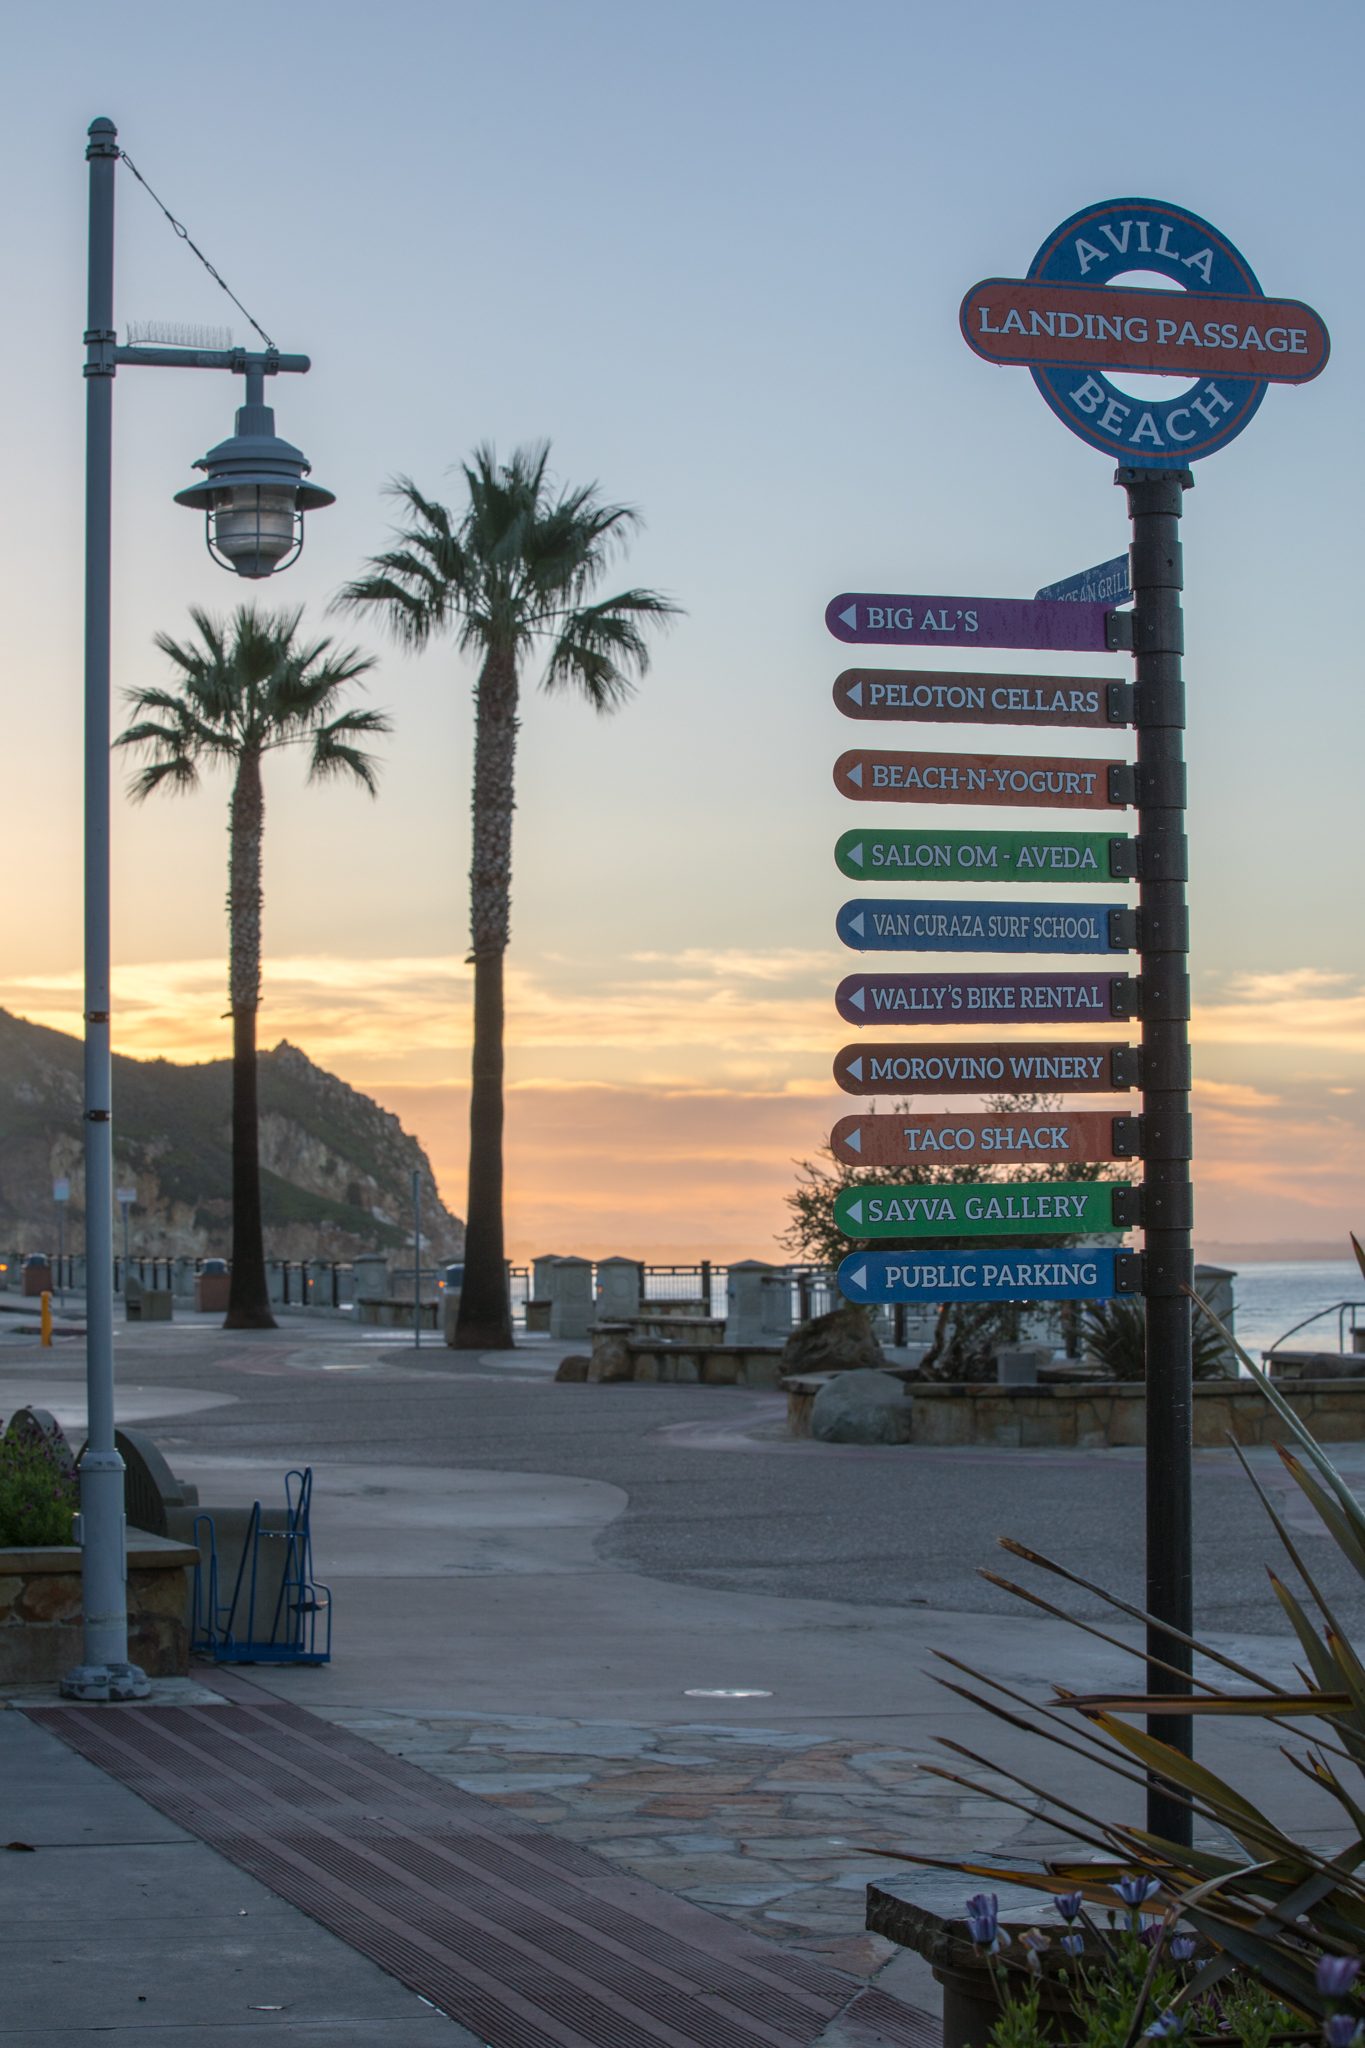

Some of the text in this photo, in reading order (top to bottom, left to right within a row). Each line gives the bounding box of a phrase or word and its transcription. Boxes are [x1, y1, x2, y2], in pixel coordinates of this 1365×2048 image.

[1073, 220, 1216, 285] AVILA
[978, 306, 1309, 355] LANDING PASSAGE
[1069, 375, 1234, 446] BEACH
[866, 606, 979, 632] BIG AL'S
[869, 683, 1099, 713] PELOTON CELLARS
[872, 764, 1097, 795] BEACH-N-YOGURT
[871, 844, 952, 867] SALON
[957, 845, 998, 867] OM
[1016, 846, 1098, 869] AVEDA
[873, 914, 1099, 939] VAN CURAZA SURF SCHOOL
[871, 985, 1103, 1010] WALLY'S BIKE RENTAL
[870, 1056, 1104, 1080] MOROVINO WINERY
[904, 1127, 1069, 1151] TACO SHACK
[868, 1195, 1088, 1222] SAYVA GALLERY
[885, 1263, 1097, 1288] PUBLIC PARKING
